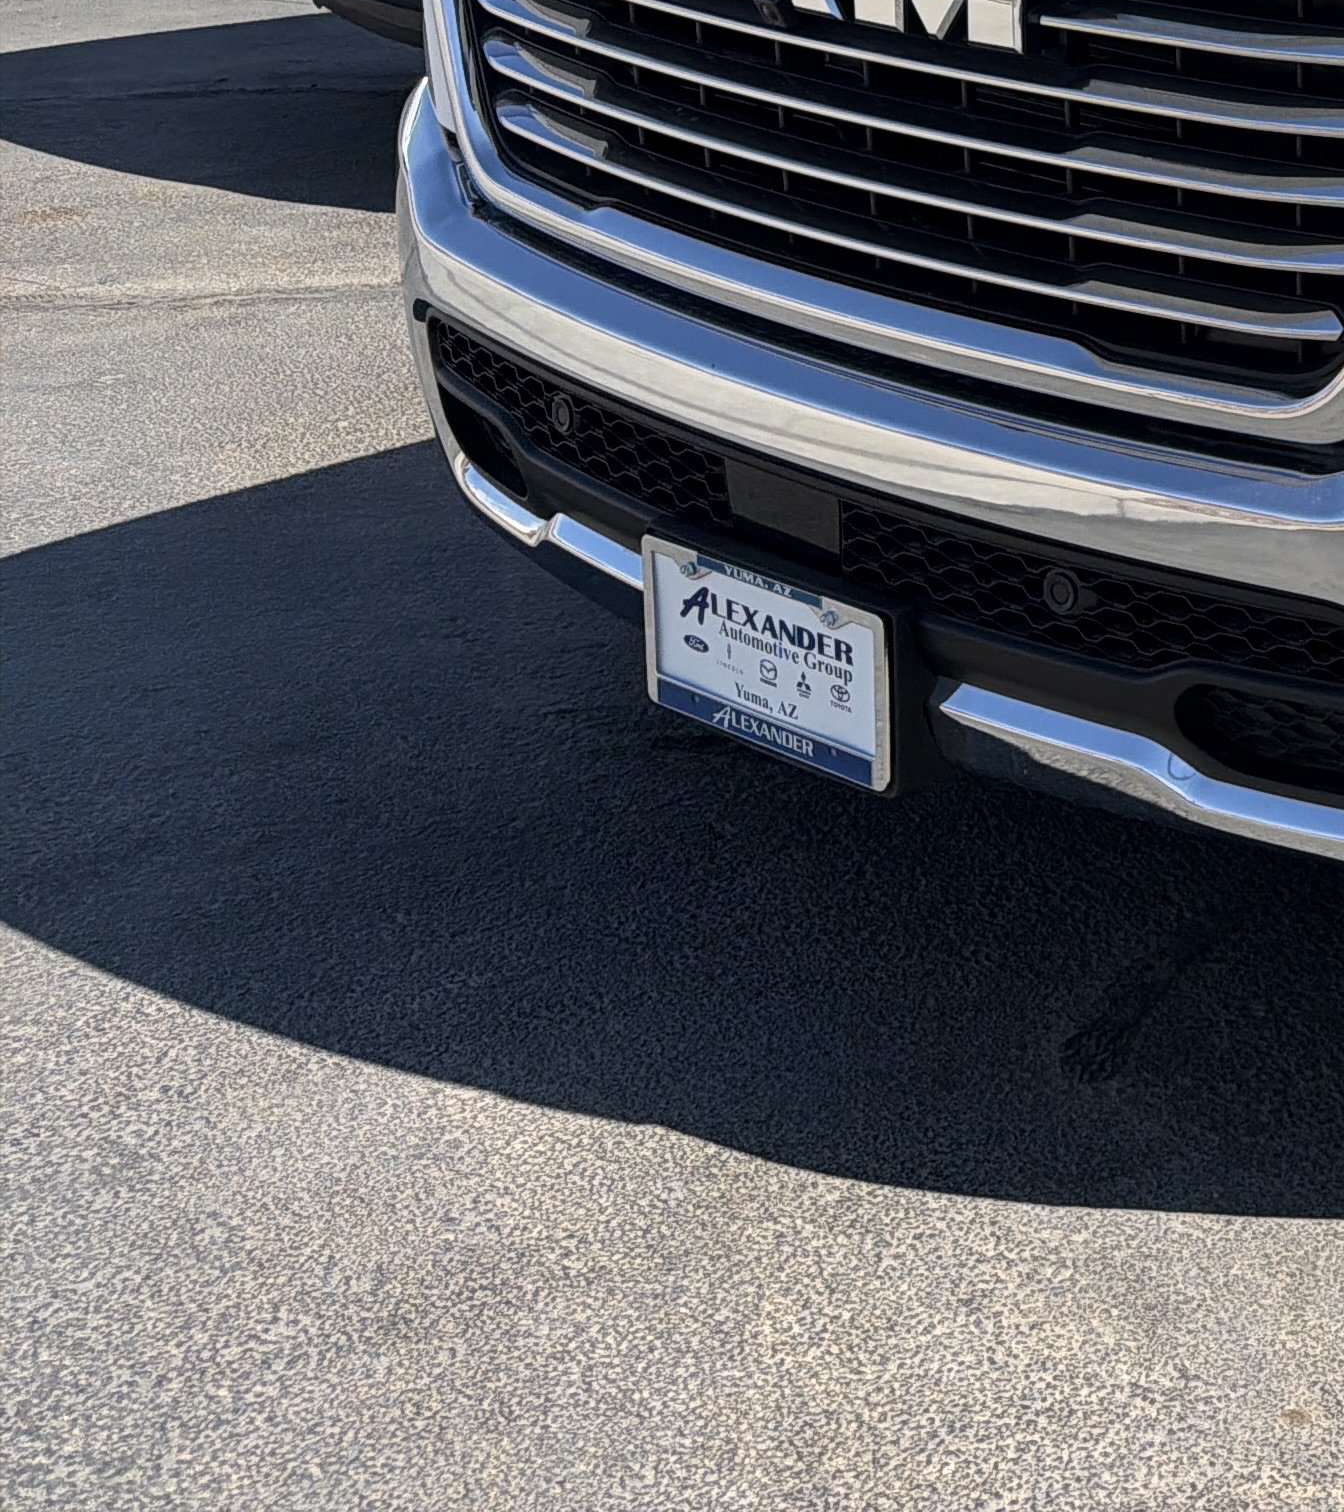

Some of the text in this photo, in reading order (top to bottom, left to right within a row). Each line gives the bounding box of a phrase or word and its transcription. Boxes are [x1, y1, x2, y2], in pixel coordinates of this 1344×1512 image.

[722, 564, 793, 598] YUMA, AZ
[680, 585, 854, 667] ALEXANDER
[718, 619, 854, 686] Automotive Group
[735, 681, 774, 714] Yuma,
[777, 700, 799, 721] AZ
[712, 705, 815, 758] ALEXANDER
